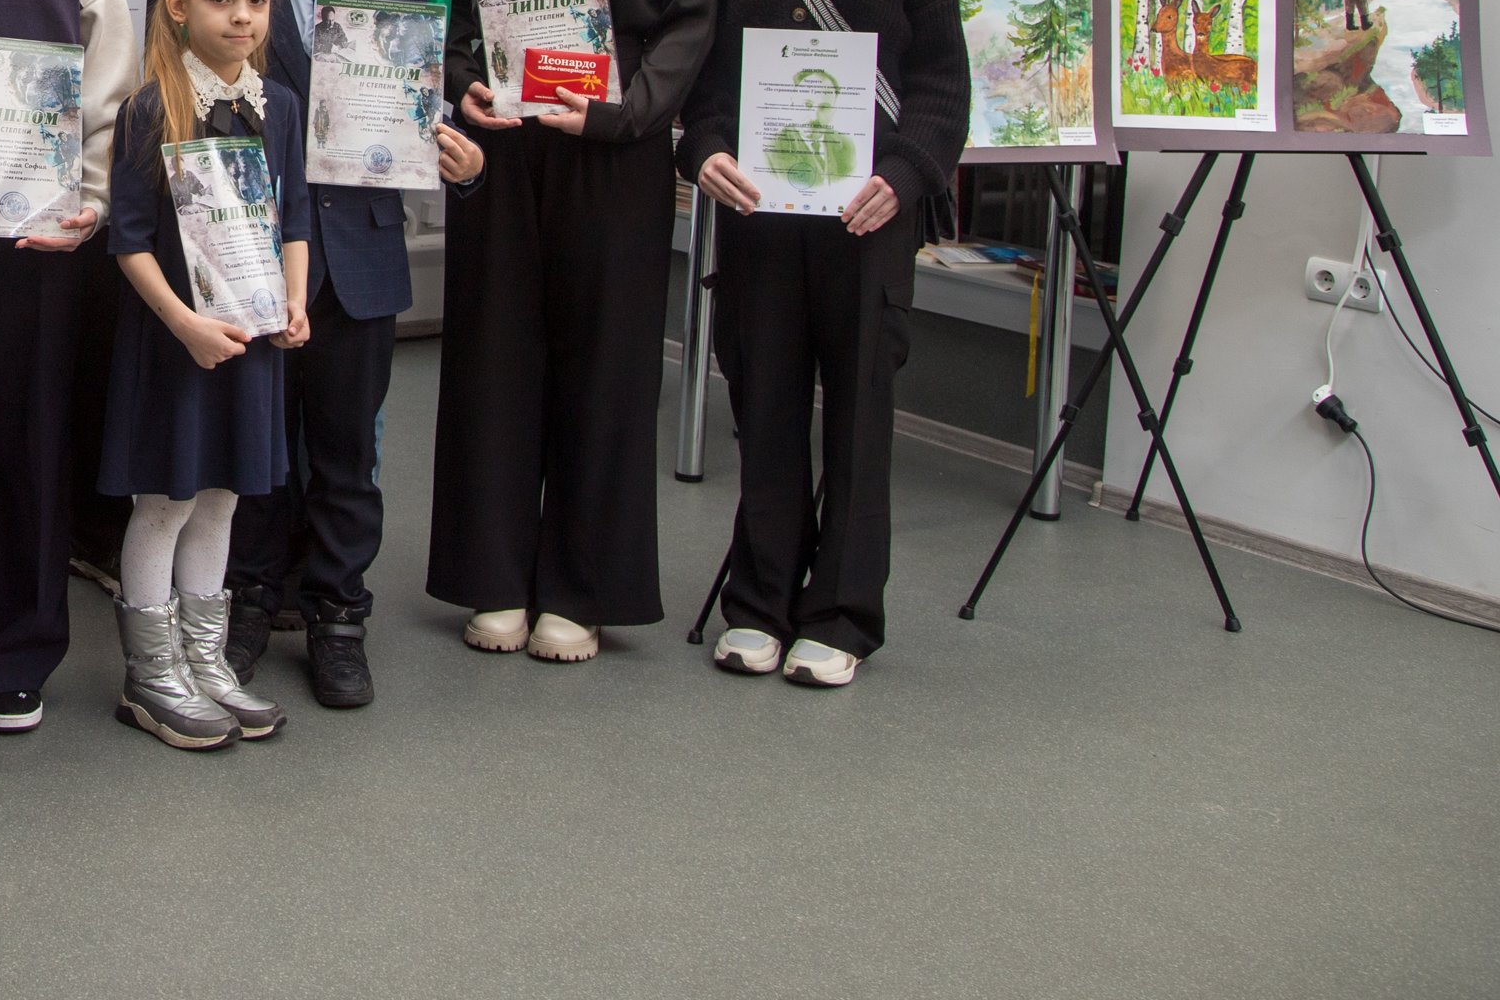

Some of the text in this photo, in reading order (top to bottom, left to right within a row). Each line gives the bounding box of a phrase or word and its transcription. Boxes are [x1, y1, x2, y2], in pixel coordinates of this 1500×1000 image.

[535, 13, 565, 22] СТЕПЕНИ
[538, 54, 596, 69] Леонардо
[339, 63, 422, 81] ДИПЛОМ
[538, 65, 596, 75] хобби-гипермаркет
[383, 116, 404, 124] Фёдор
[24, 163, 47, 171] София
[206, 204, 268, 226] ДИПЛОМ
